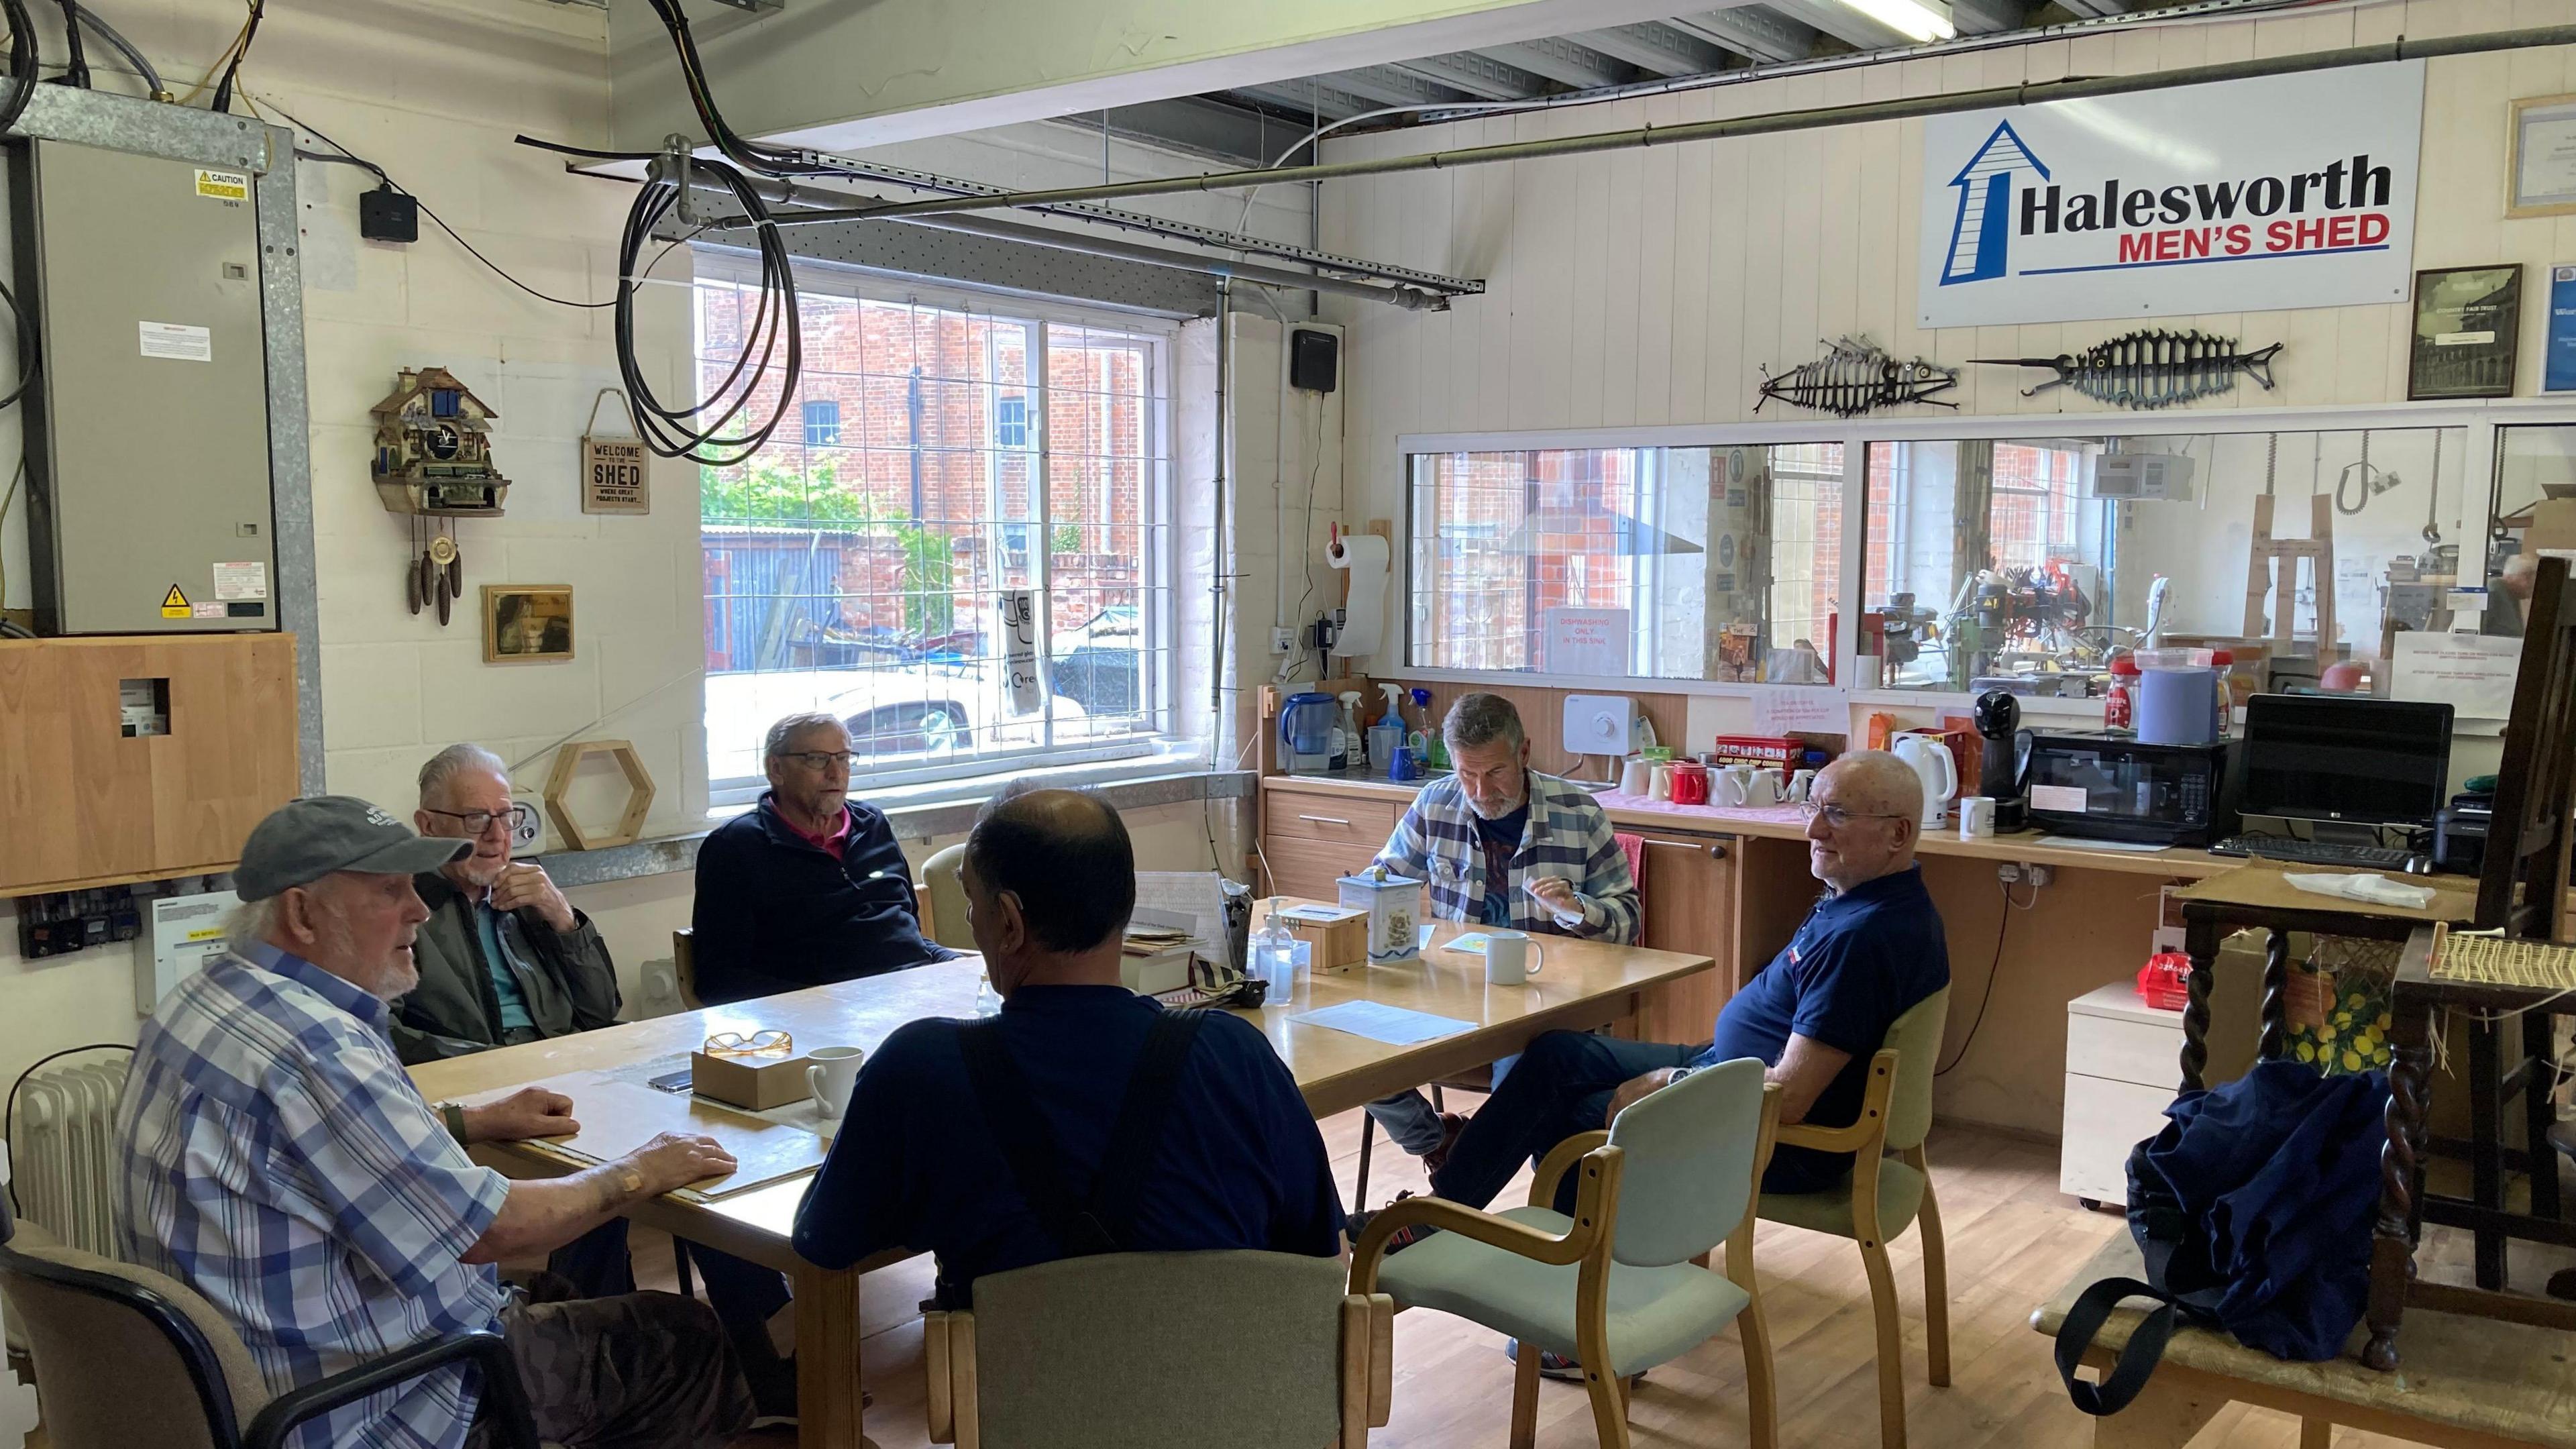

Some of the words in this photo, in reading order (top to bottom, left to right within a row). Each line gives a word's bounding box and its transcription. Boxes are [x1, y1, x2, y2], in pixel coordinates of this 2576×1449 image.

[212, 174, 244, 184] CAUTION
[2020, 154, 2391, 236] Halesworth
[2119, 223, 2251, 263] MEN'S
[2266, 213, 2390, 252] SHED
[594, 445, 640, 458] WELCOME
[594, 464, 639, 486] SHED
